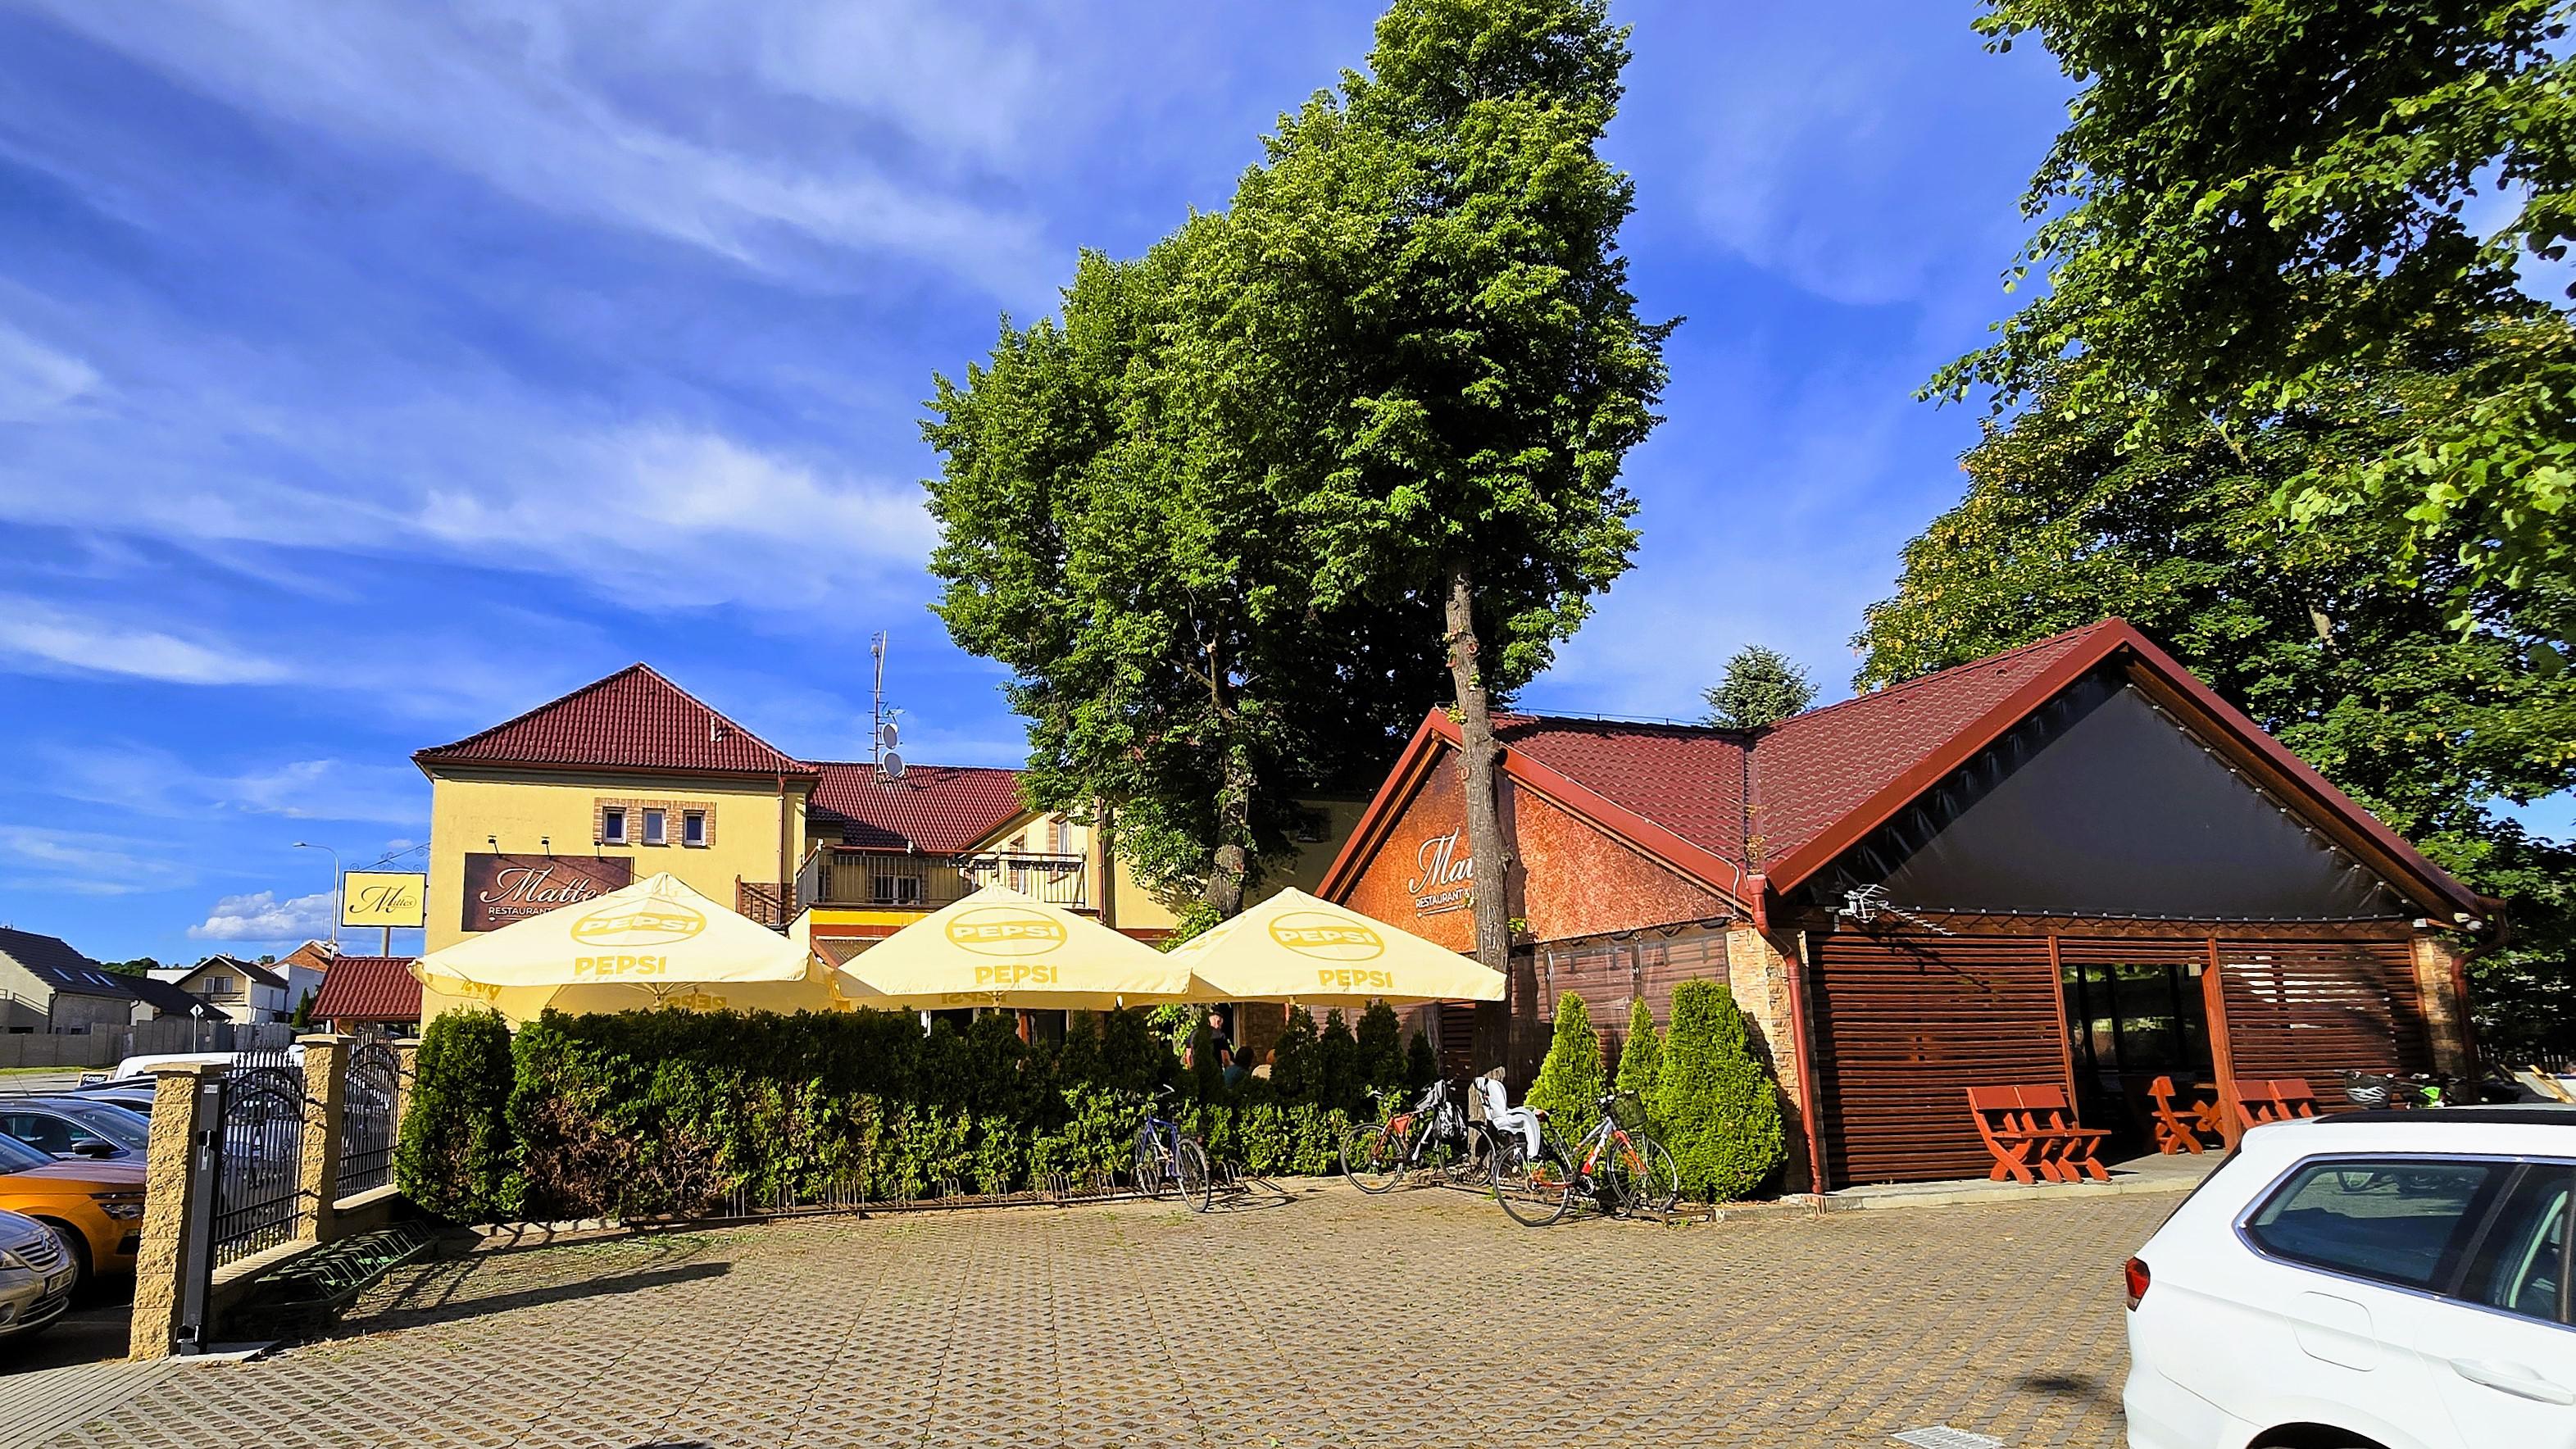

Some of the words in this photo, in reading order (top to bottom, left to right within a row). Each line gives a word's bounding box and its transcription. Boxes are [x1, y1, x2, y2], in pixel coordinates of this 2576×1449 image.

[1408, 826, 1474, 893] Mat
[1415, 888, 1463, 908] RESTAURANT
[579, 915, 700, 932] PEPSI
[952, 924, 1061, 938] PEPSI
[1275, 930, 1377, 943] PEPSI
[575, 956, 667, 975] PEPSI
[975, 965, 1058, 983] PEPSI
[1318, 970, 1393, 988] PEPSI
